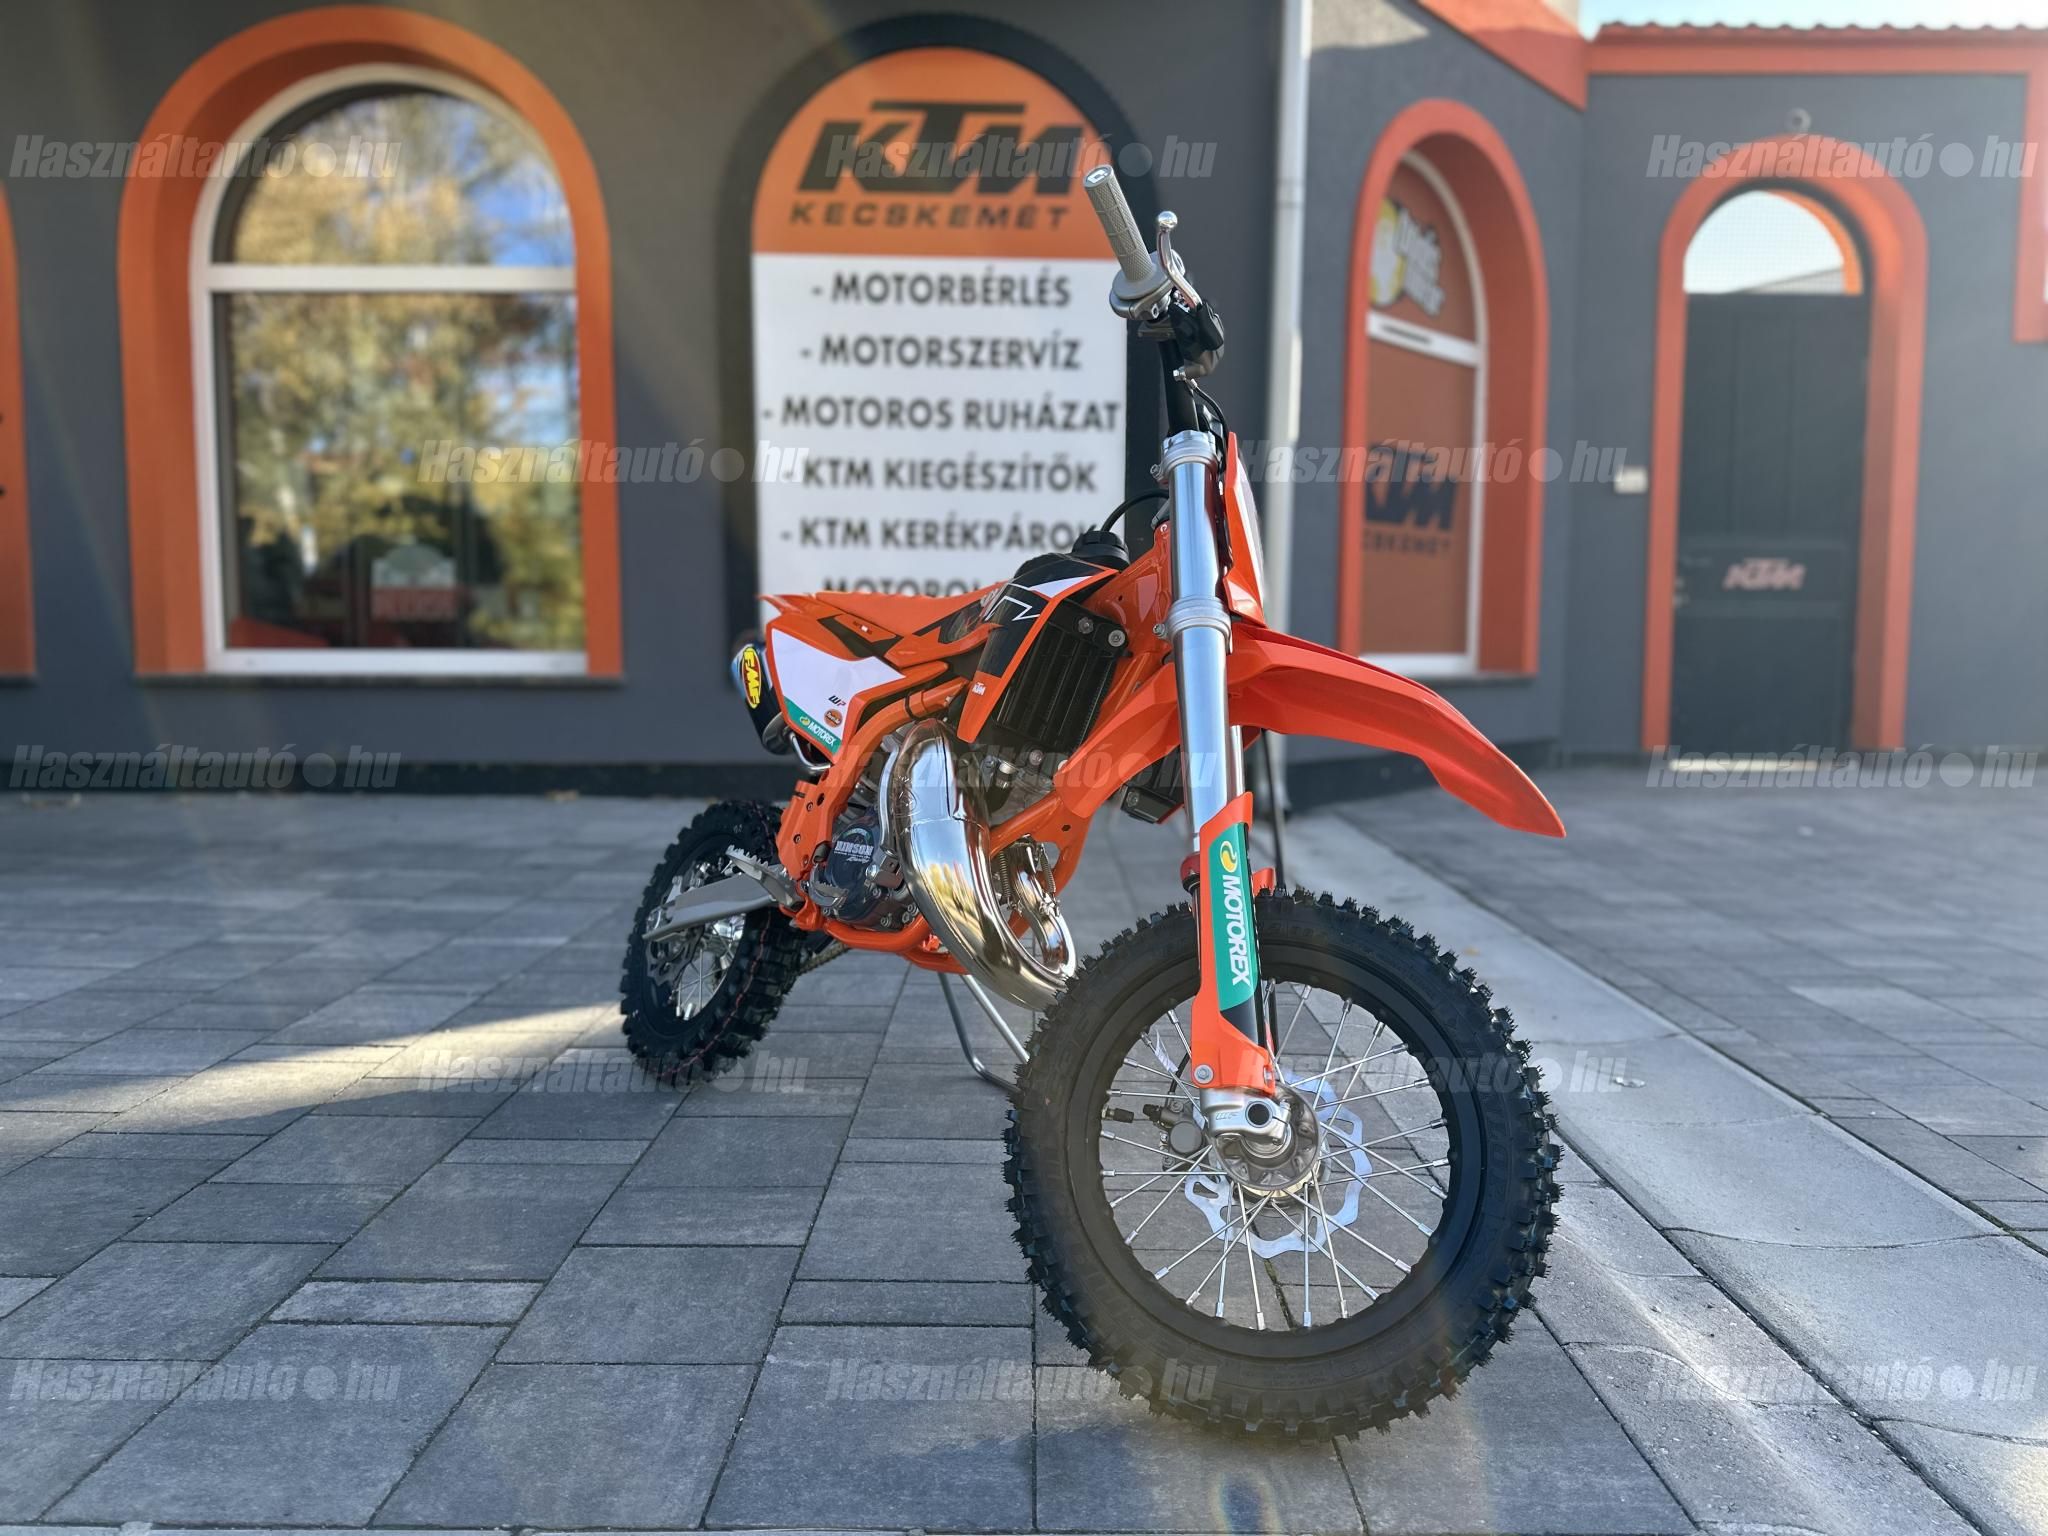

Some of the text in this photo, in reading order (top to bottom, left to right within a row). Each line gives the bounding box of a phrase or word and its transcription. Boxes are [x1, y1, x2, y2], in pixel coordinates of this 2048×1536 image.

[797, 100, 1085, 195] KTM
[831, 266, 1072, 307] MOTORBÉRLÉS
[819, 331, 1083, 370] MOTORSZERVÍZ
[781, 396, 953, 429] MOTOROS
[965, 390, 1121, 431] RUHÁZAT
[802, 458, 875, 488] KTM
[801, 517, 871, 547] KTM
[1722, 557, 1806, 590] KTM
[743, 650, 760, 704] FMF
[807, 721, 837, 747] MOTOREX
[1222, 874, 1250, 986] MOTOREX
